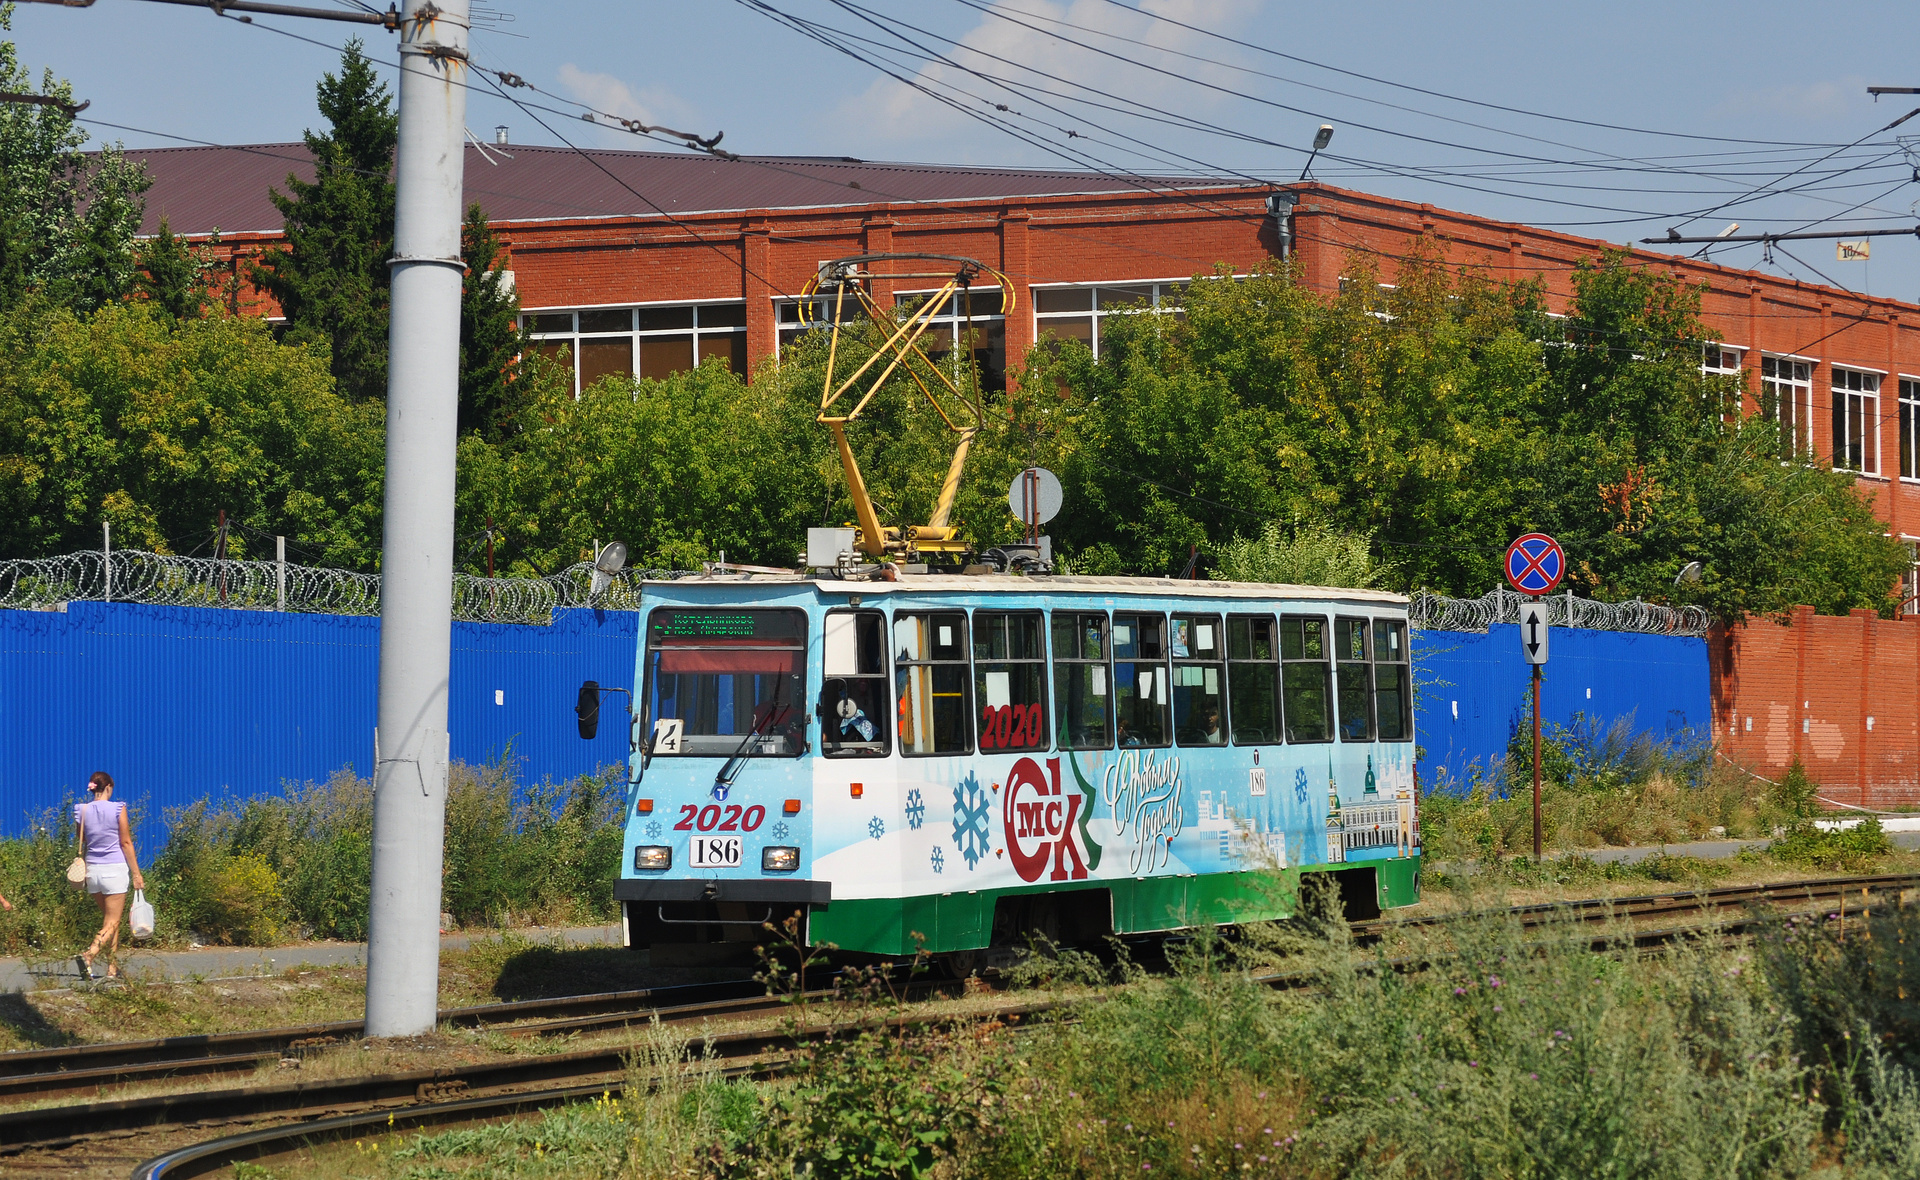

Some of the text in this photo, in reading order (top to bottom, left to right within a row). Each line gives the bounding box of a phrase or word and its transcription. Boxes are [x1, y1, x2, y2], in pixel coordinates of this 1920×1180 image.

[661, 723, 677, 751] 4
[980, 703, 1043, 749] 2020
[1250, 771, 1265, 792] 186
[673, 804, 766, 832] 2020
[695, 838, 739, 864] 186
